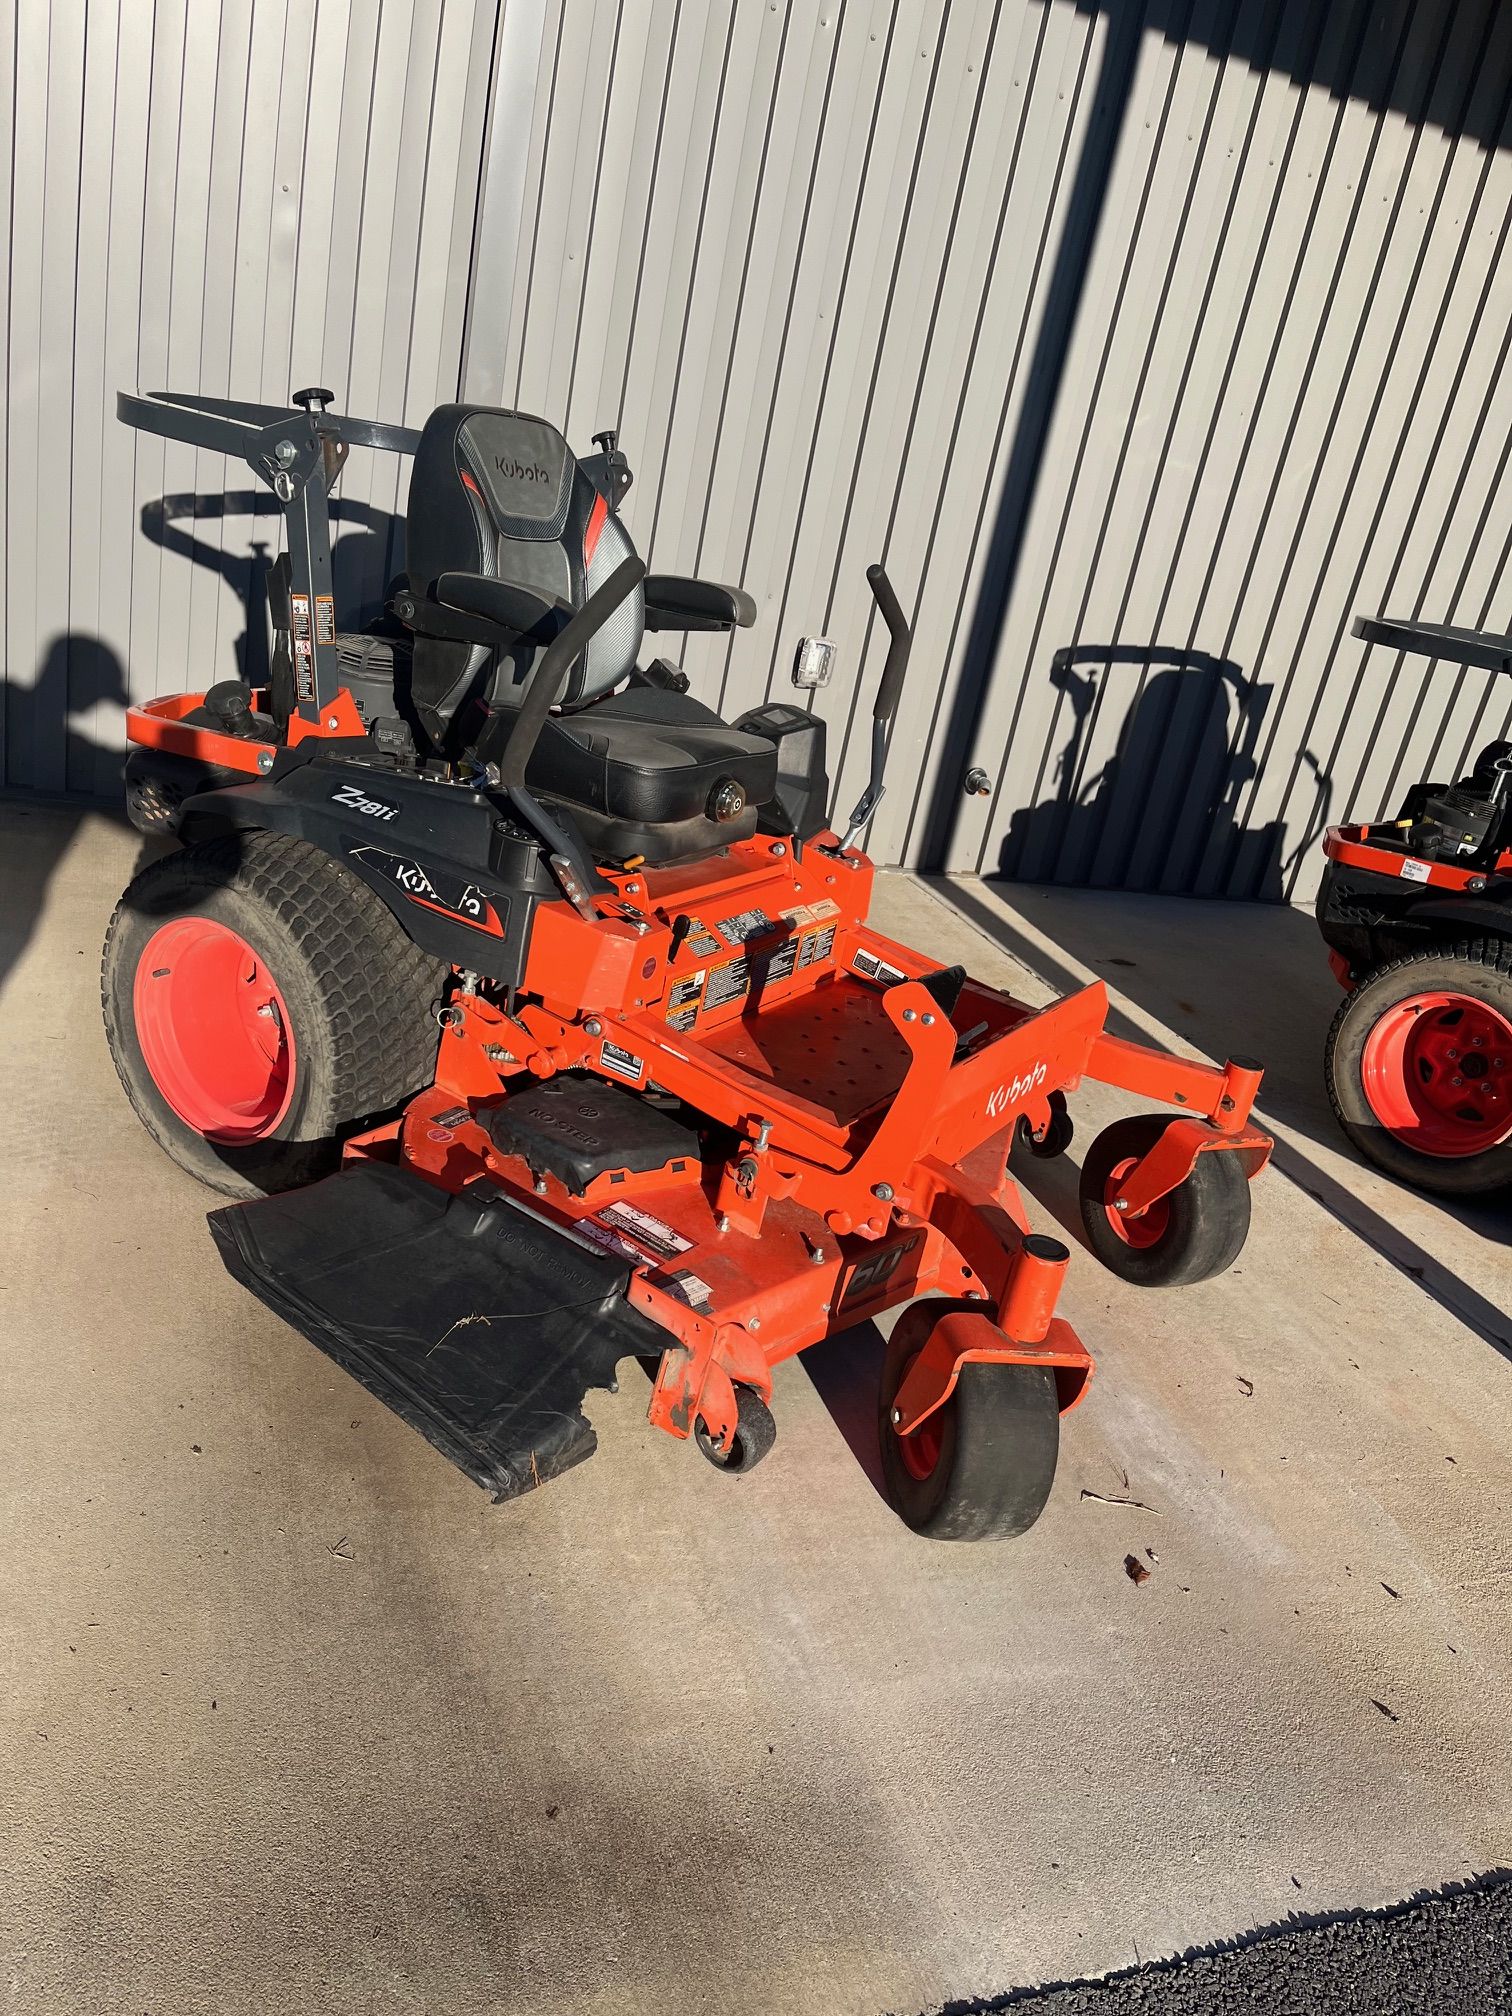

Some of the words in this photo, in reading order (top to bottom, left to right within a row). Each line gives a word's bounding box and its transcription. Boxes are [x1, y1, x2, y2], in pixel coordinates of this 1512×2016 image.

[495, 455, 549, 483] Kubota
[331, 784, 400, 821] Z781i
[985, 1060, 1047, 1118] Kubota
[528, 1107, 554, 1126] NO
[555, 1122, 600, 1147] STEP
[496, 1228, 516, 1244] DO
